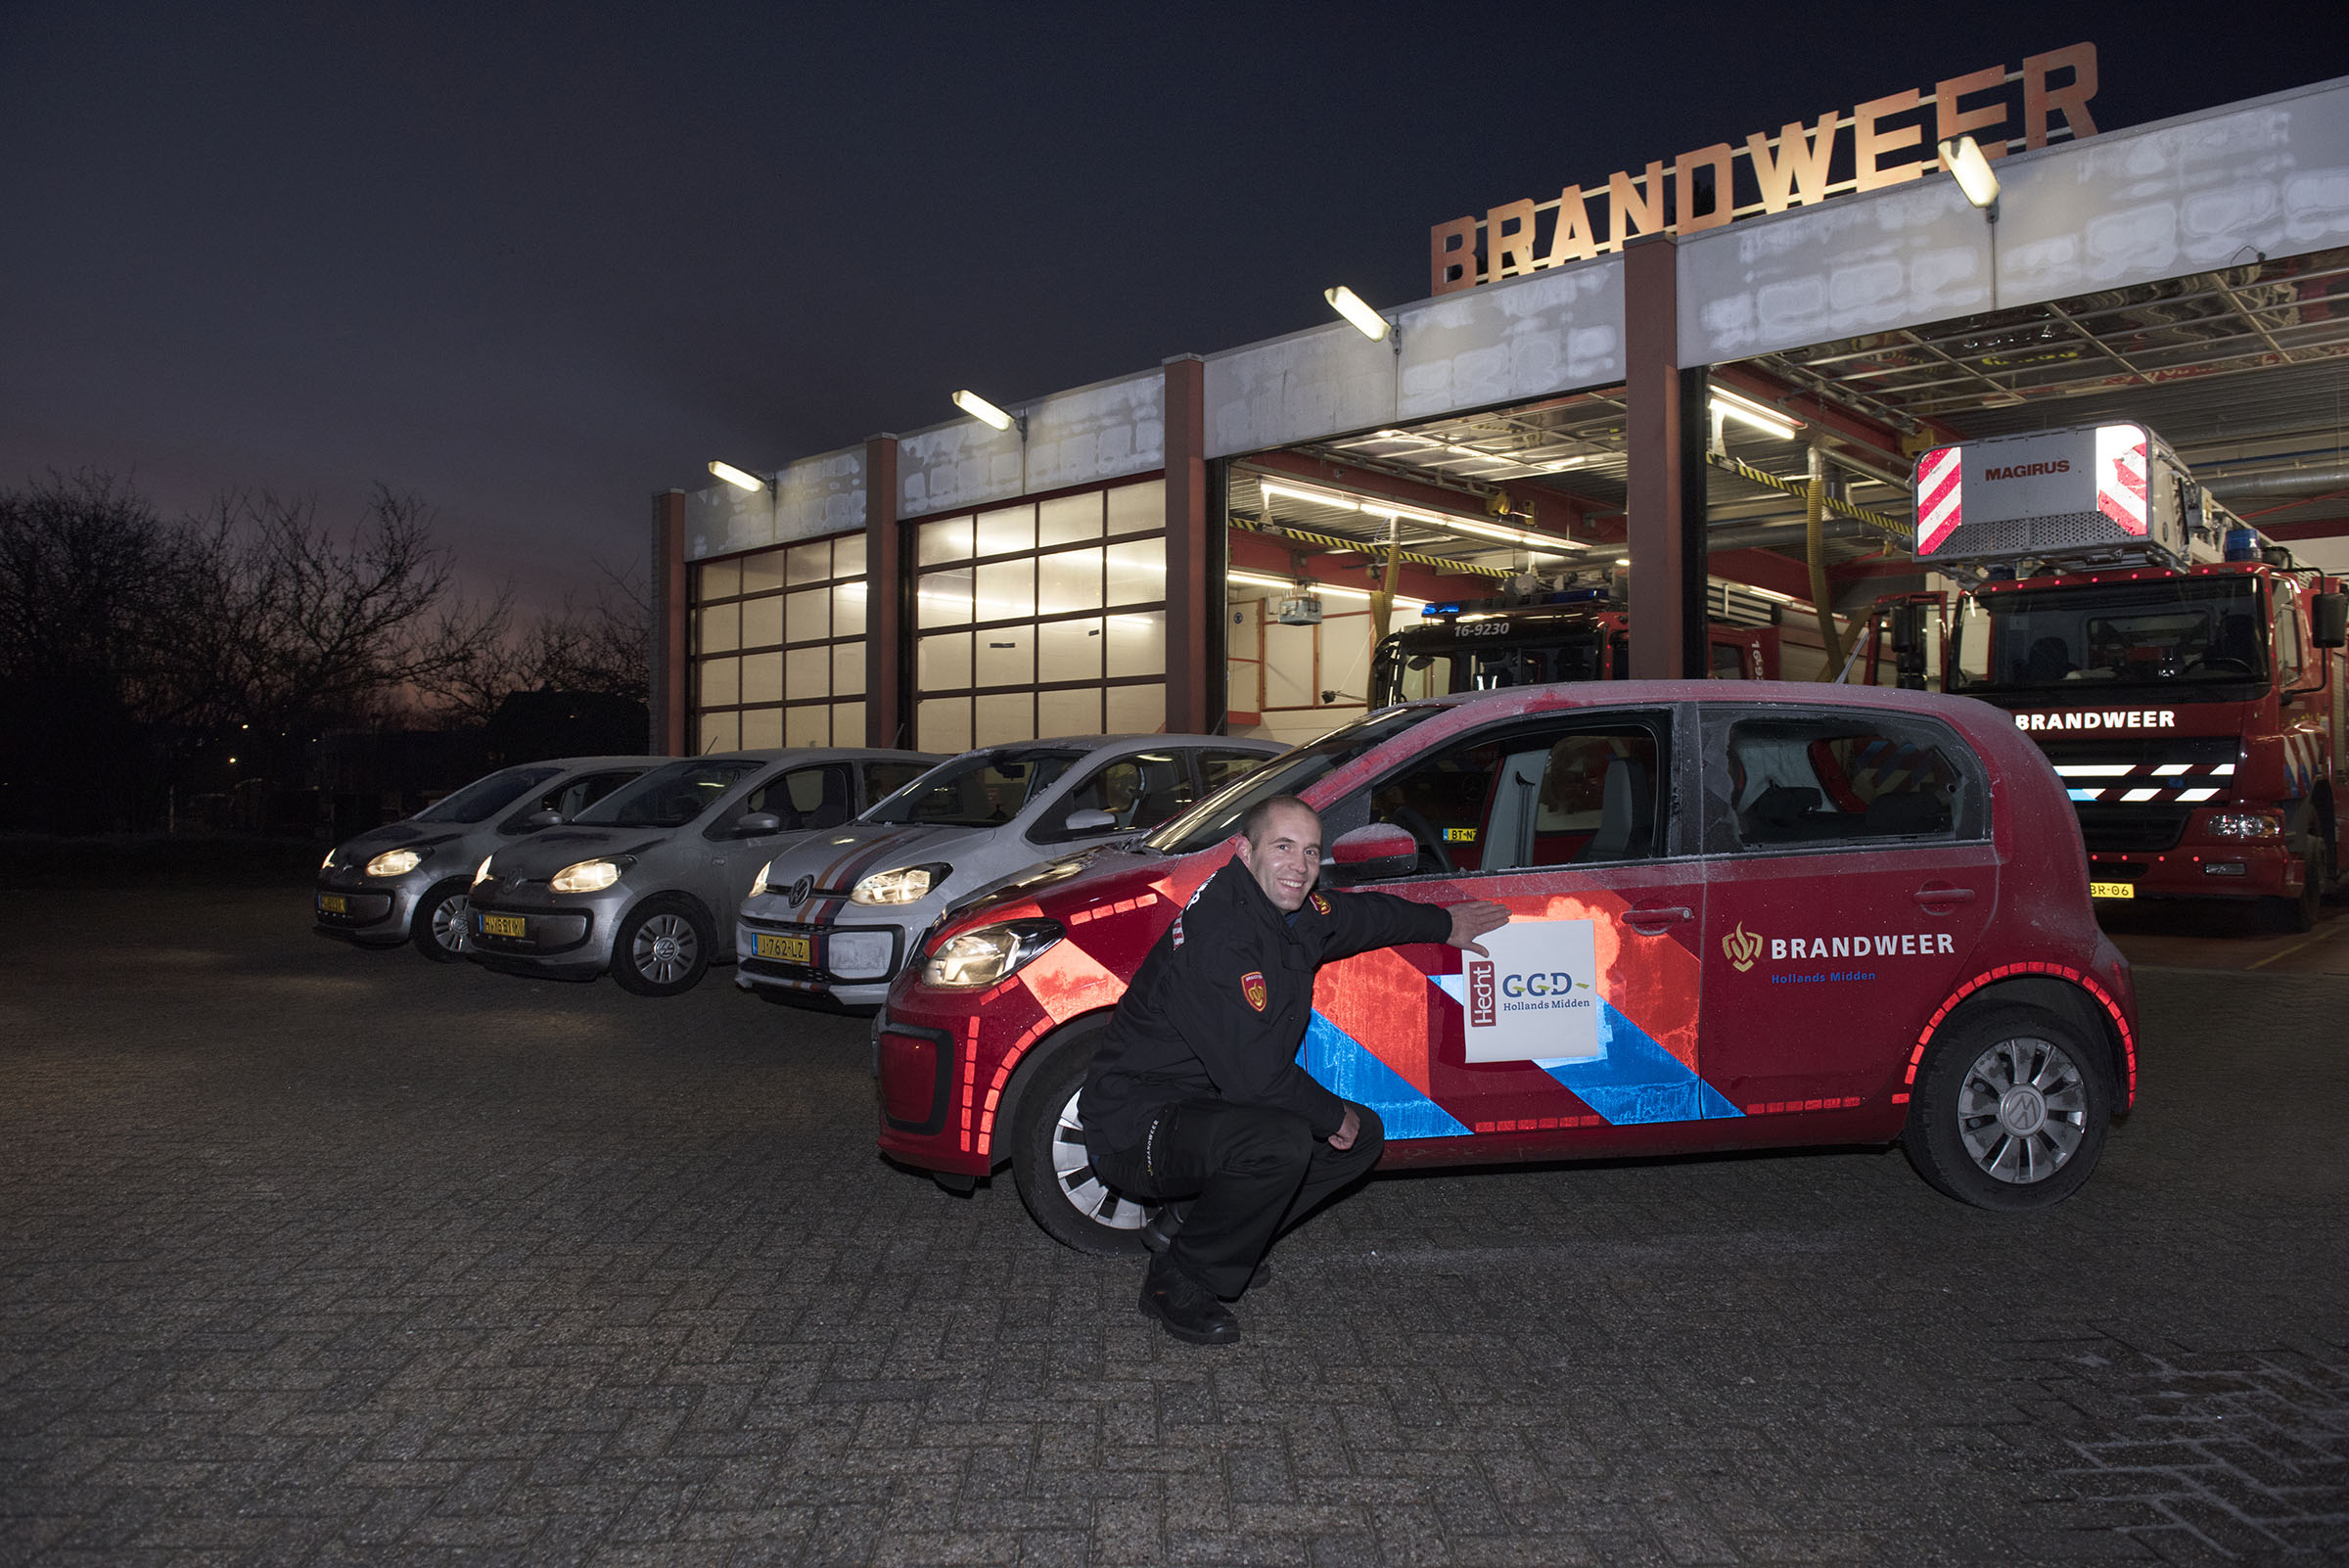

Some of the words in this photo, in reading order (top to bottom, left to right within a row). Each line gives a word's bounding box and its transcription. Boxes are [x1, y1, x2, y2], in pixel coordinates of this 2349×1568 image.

[1431, 41, 2099, 298] BRANDWEER
[1985, 459, 2070, 482] MAGIRUS
[1454, 622, 1510, 637] 16-9230
[1752, 640, 1763, 680] 16-9
[2015, 711, 2176, 730] BRANDWEER
[1771, 933, 1956, 960] BRANDWEER
[1772, 973, 1825, 984] Hollands
[1830, 971, 1876, 982] Midden
[1473, 964, 1493, 1024] Hecht
[1503, 1001, 1549, 1011] Hollands
[1551, 998, 1590, 1009] Midden
